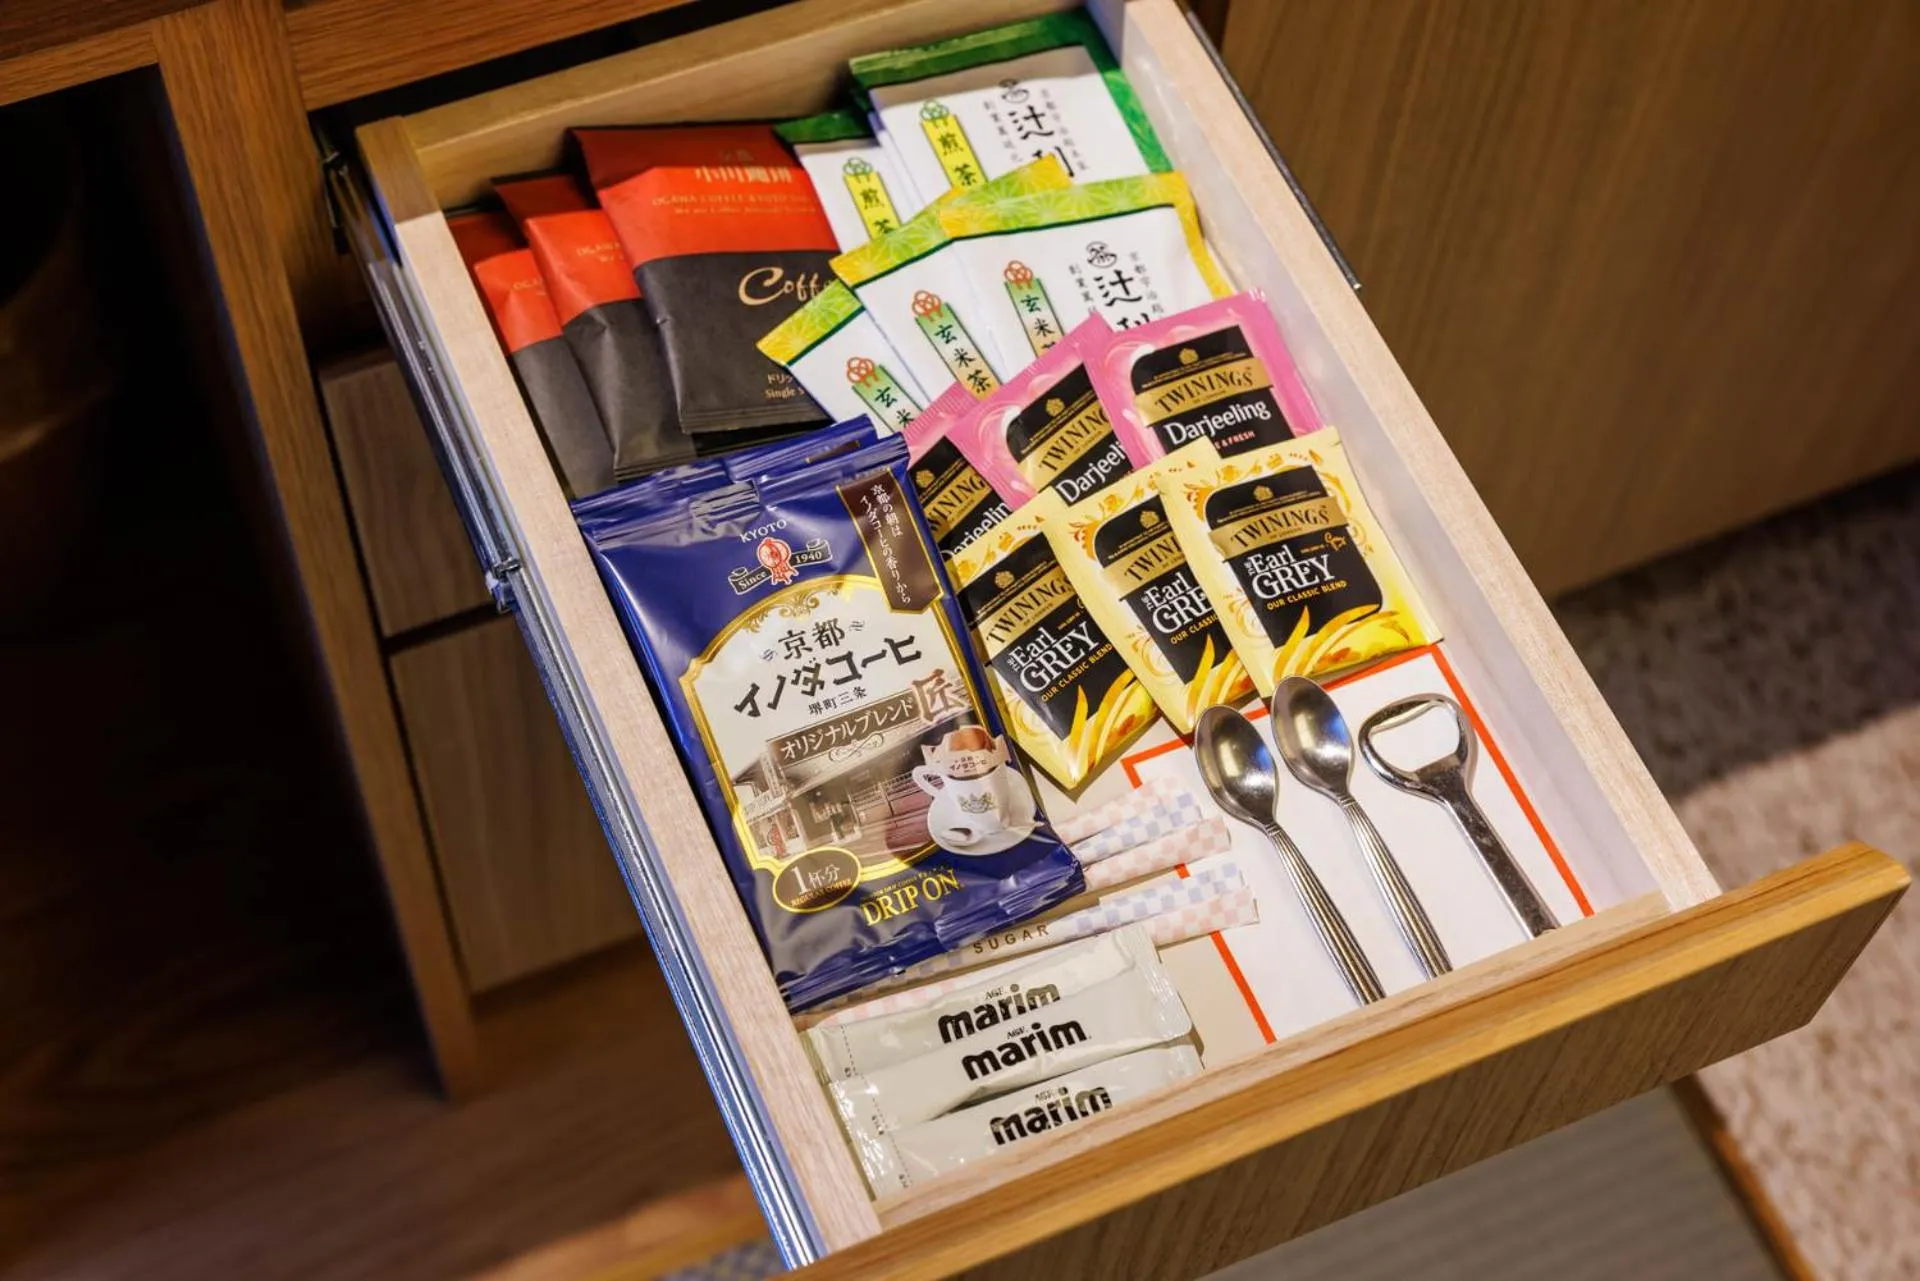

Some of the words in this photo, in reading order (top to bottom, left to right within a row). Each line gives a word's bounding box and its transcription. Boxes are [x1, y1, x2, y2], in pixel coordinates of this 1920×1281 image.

[938, 132, 976, 186] 煎茶
[738, 266, 832, 307] Coff
[935, 323, 992, 394] 玄米茶
[875, 385, 915, 429] 玄米
[1154, 370, 1254, 413] TWININGS
[1163, 401, 1272, 446] Darjeeling
[1055, 441, 1126, 503] Darjeeli
[740, 519, 788, 544] KYOTO
[1230, 508, 1330, 548] TWININGS
[738, 570, 768, 590] Since
[795, 551, 823, 564] 1940
[1248, 544, 1297, 573] Earl
[1252, 554, 1336, 600] GREY
[1145, 571, 1192, 607] Earl
[1153, 586, 1213, 634] GRE
[1267, 600, 1286, 611] OUR
[1286, 588, 1320, 603] CLASSIC
[1321, 579, 1348, 594] BLEND
[778, 617, 845, 660] 京都
[1008, 627, 1057, 667] Earl
[1020, 621, 1101, 692] GREY
[1170, 630, 1189, 645] OUR
[734, 635, 922, 717] イノダコーヒ
[1041, 684, 1059, 702] OUR
[1058, 661, 1090, 688] CLASSIC
[808, 686, 868, 715] 堺町三条
[781, 697, 913, 761] オリジナルブレンド
[860, 885, 919, 927] DRIP
[921, 868, 961, 902] ON
[973, 924, 1049, 955] SUGAR
[938, 983, 1061, 1045] marim
[961, 1020, 1088, 1081] marim
[990, 1086, 1113, 1146] marim
